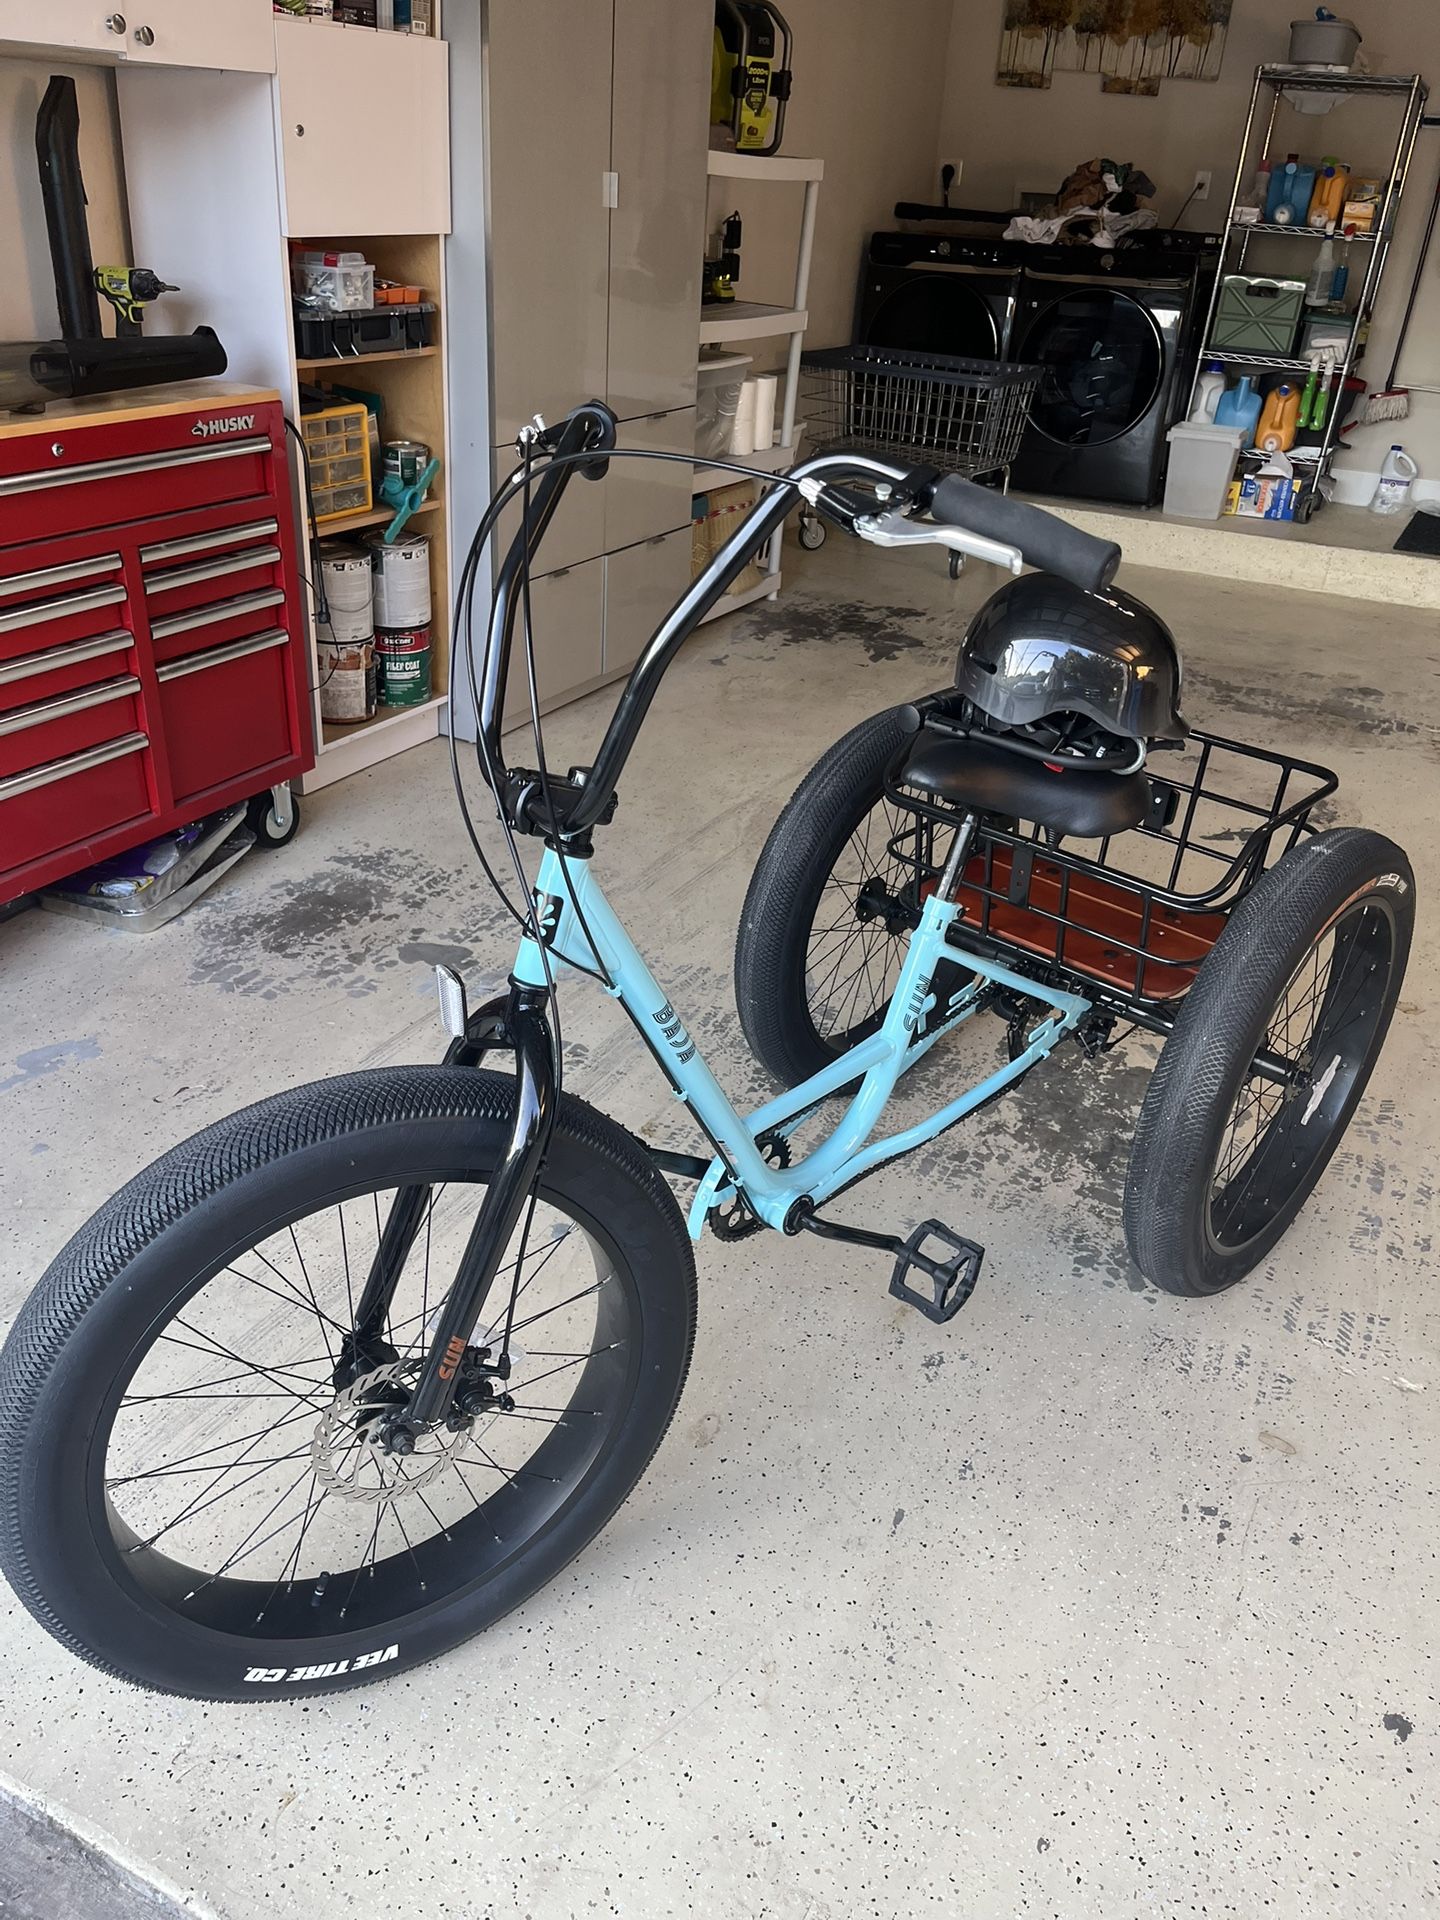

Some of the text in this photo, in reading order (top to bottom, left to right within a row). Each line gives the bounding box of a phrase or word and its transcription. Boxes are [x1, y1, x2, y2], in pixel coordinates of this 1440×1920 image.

[208, 414, 255, 435] HUSKY
[438, 1335, 467, 1380] SUN
[243, 1643, 399, 1682] VEE TIRE CO.
